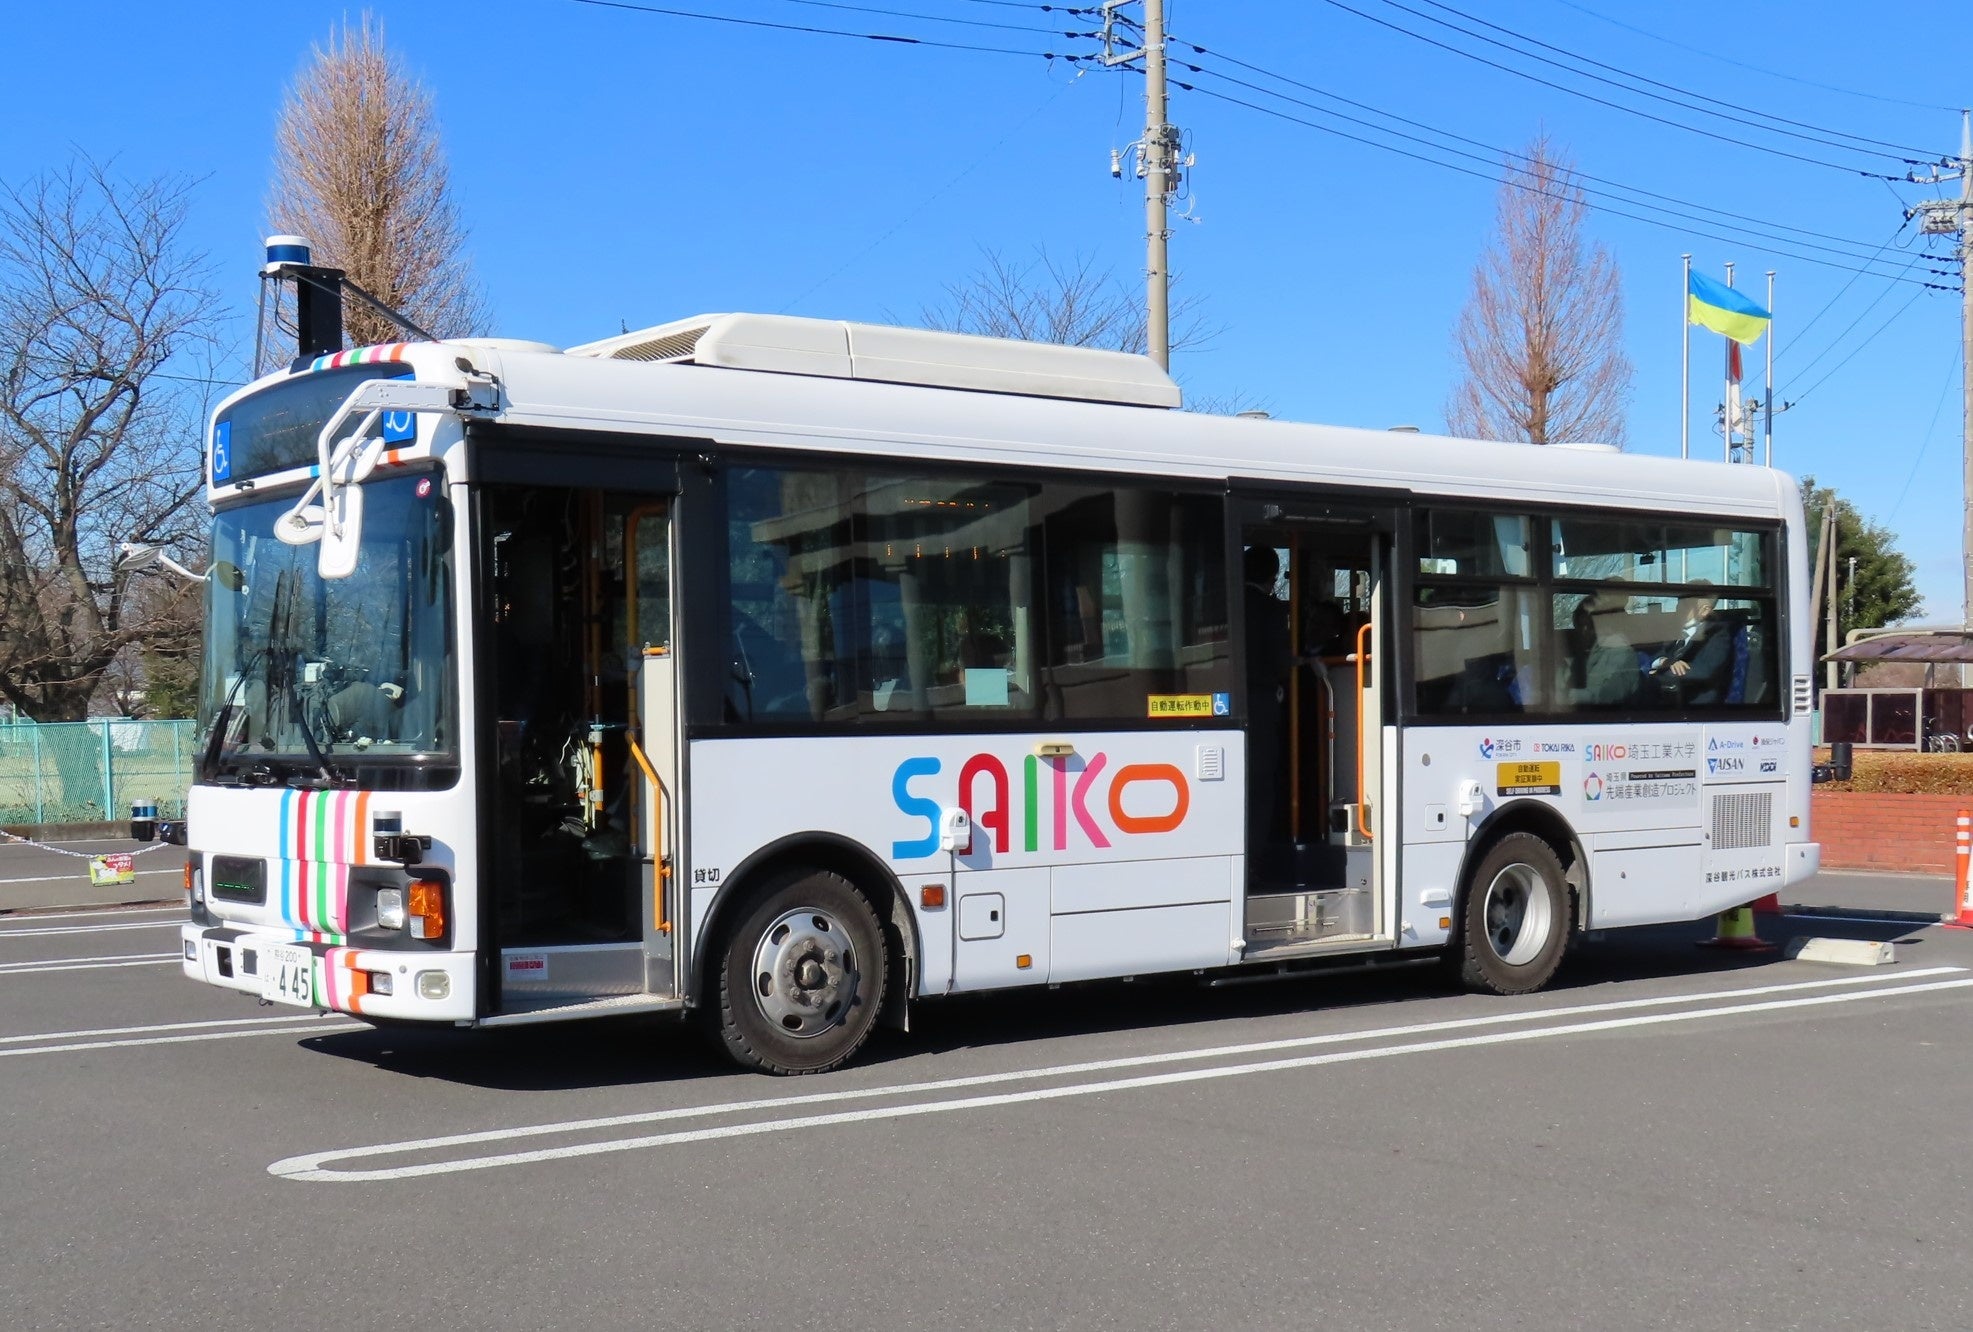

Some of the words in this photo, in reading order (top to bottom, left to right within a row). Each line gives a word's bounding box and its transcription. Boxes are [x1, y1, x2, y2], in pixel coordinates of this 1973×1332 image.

[1151, 700, 1209, 711] 自動運転作動中
[1495, 739, 1522, 751] 深谷市
[1541, 743, 1560, 752] TOKAI
[1561, 743, 1575, 752] RIKA
[1628, 742, 1695, 760] 埼玉工業大学
[1719, 740, 1744, 749] A-Drive
[1585, 744, 1626, 761] SAIKO
[1606, 772, 1627, 782] 埼玉県
[1606, 783, 1697, 799] 先端産業創造プロジェクト
[892, 752, 1190, 859] SAIKO
[694, 868, 720, 884] 貸切
[1705, 866, 1781, 883] 深谷観光バス株式会社
[285, 950, 298, 963] 200
